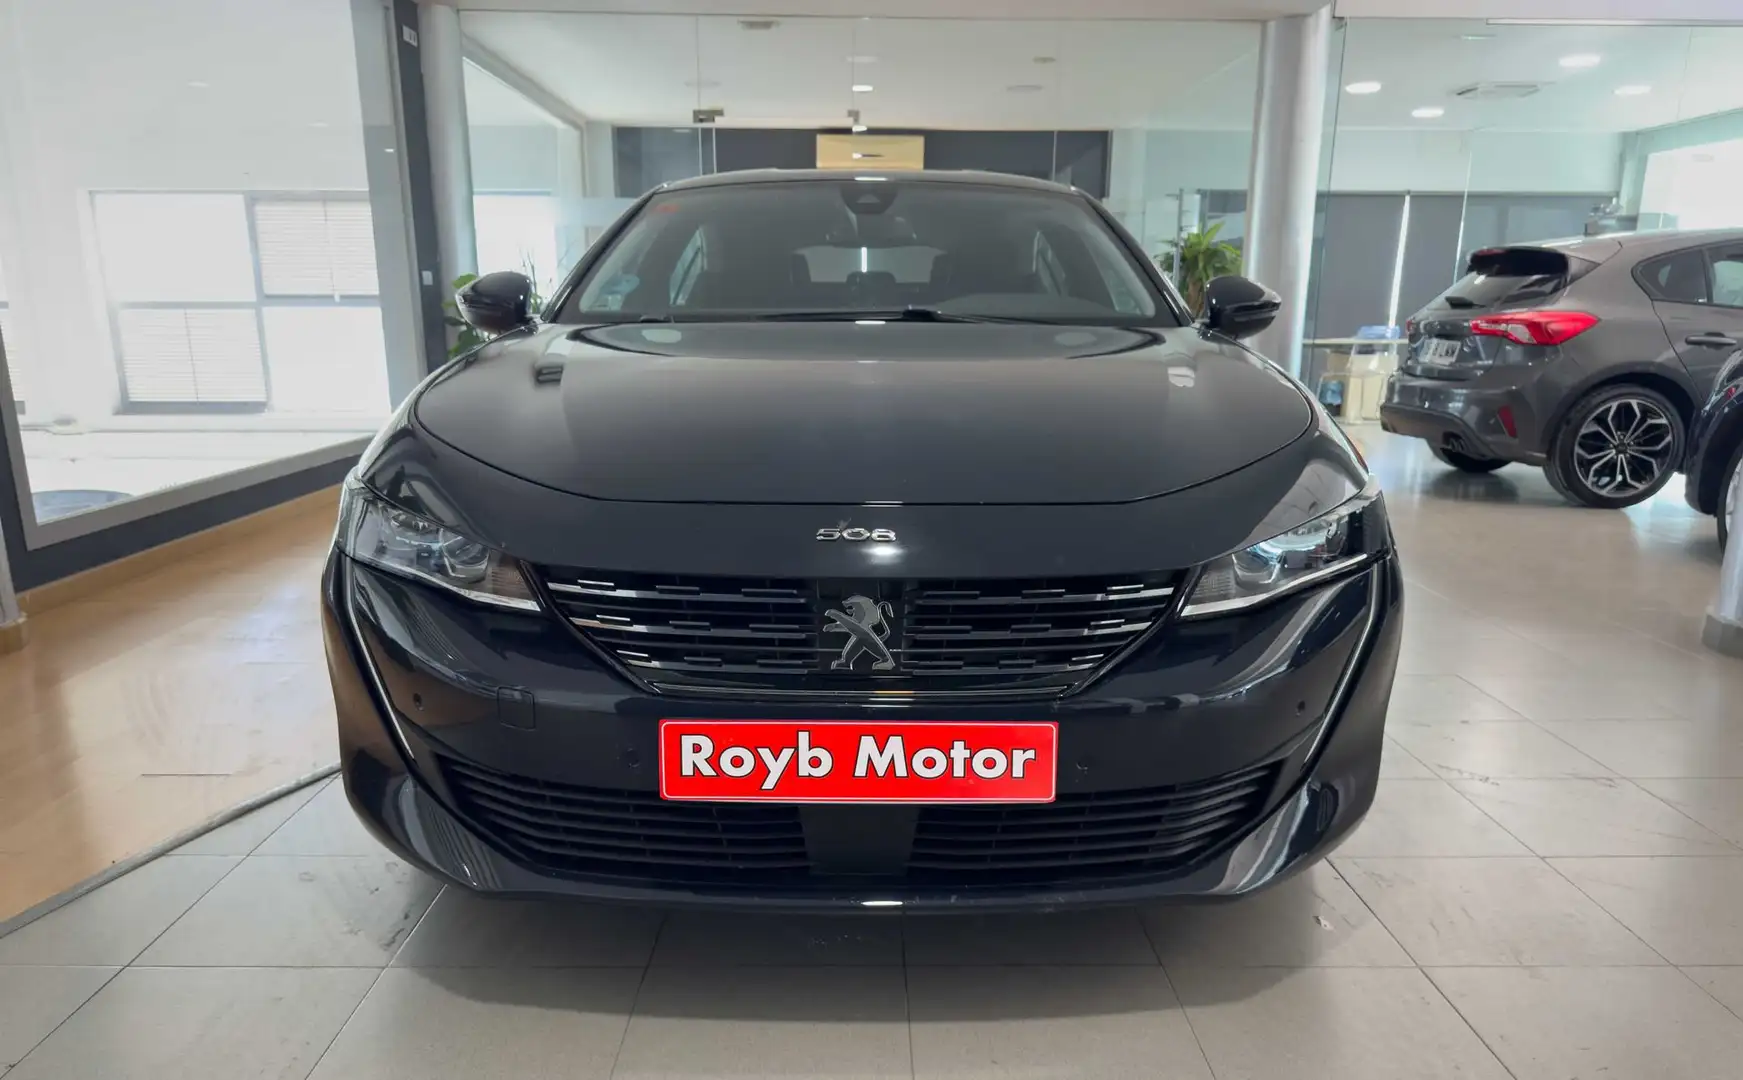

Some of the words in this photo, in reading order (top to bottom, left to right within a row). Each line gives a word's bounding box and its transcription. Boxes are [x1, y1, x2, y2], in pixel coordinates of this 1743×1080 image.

[816, 527, 896, 541] 508
[679, 730, 834, 790] Royb
[852, 734, 1036, 779] Motor
